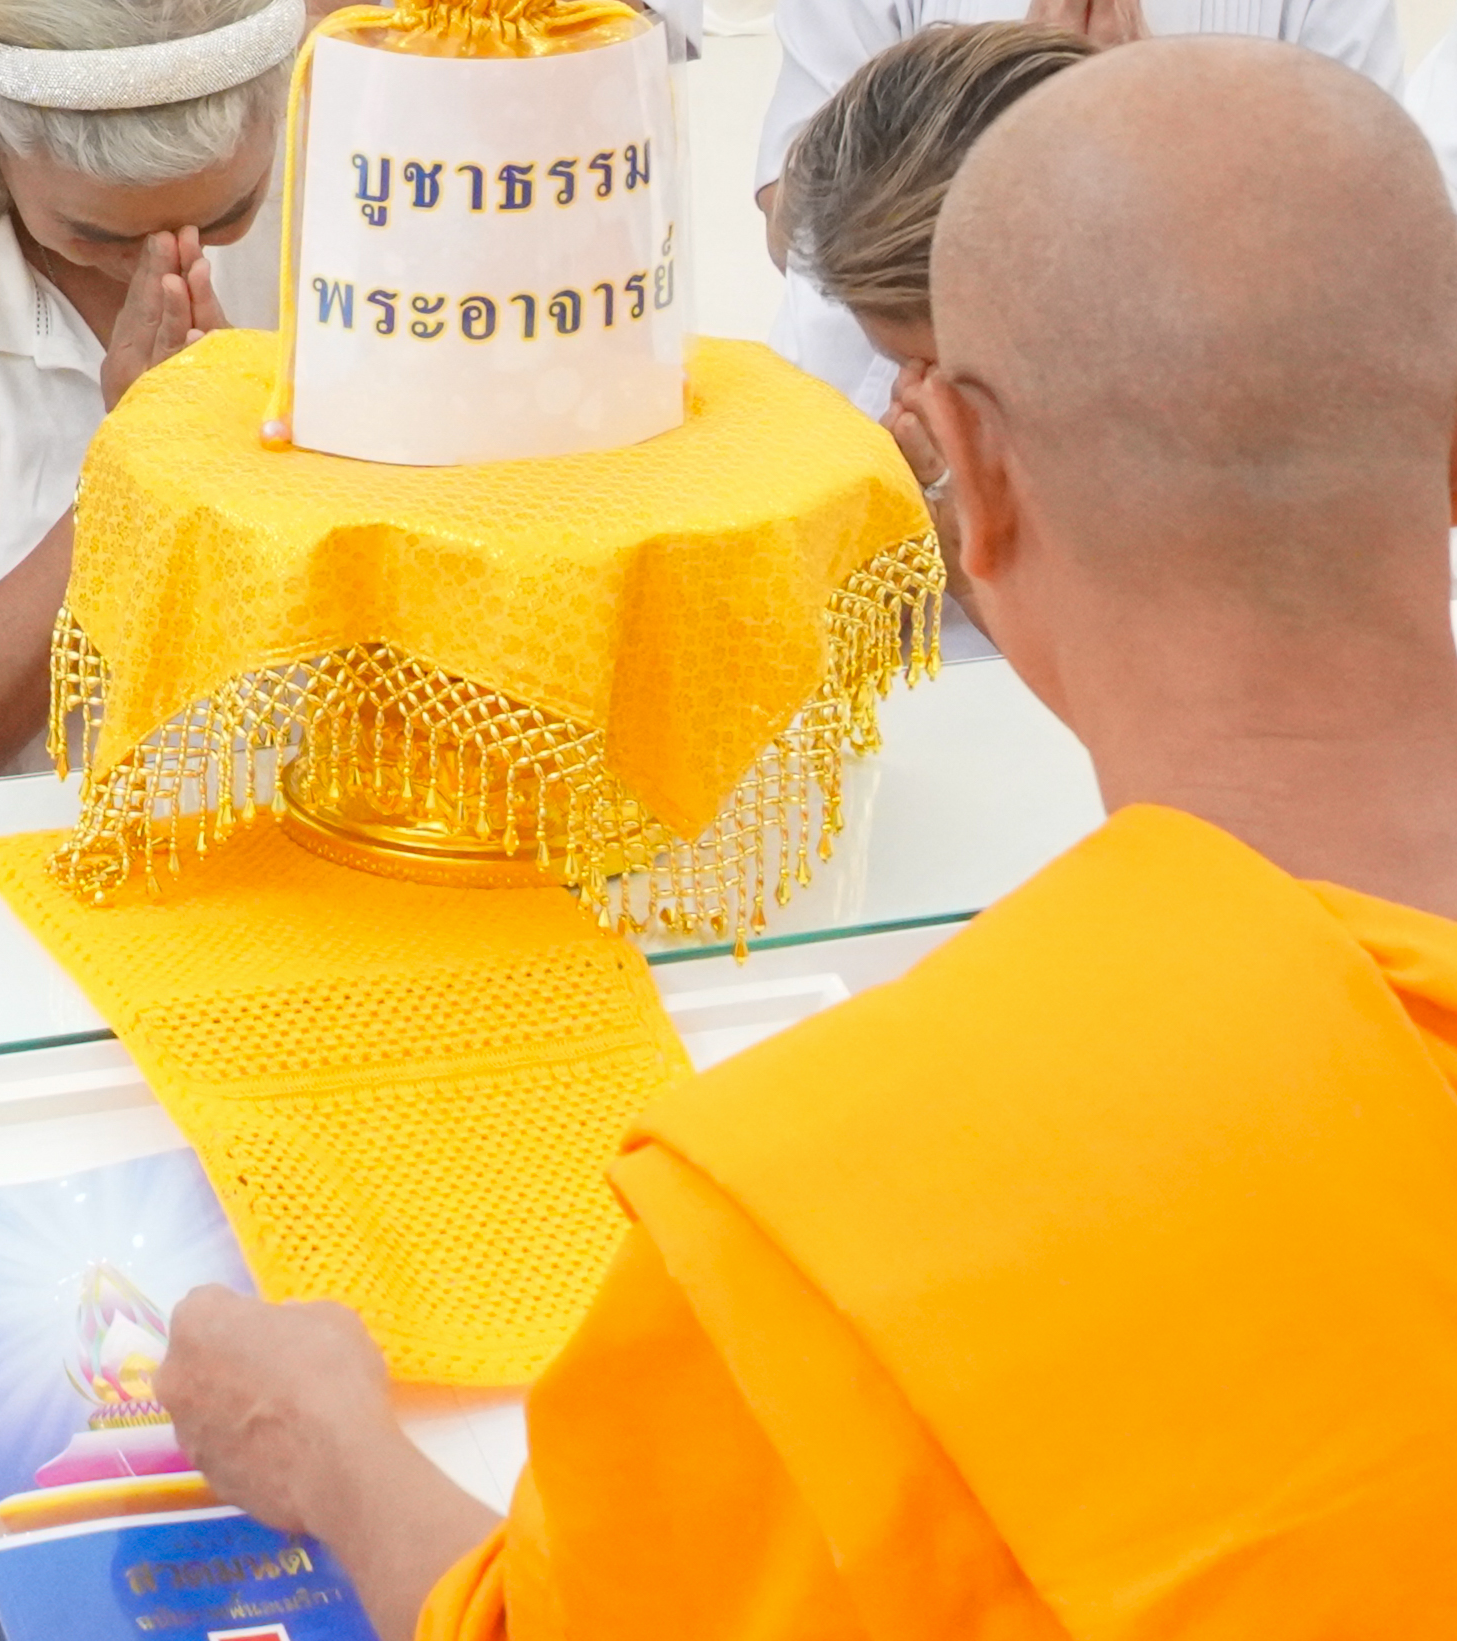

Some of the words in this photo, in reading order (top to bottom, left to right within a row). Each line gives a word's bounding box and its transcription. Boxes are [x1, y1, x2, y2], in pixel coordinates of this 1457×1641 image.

[351, 139, 651, 226] บูชาธรรม
[312, 224, 675, 341] พระอาจารย์
